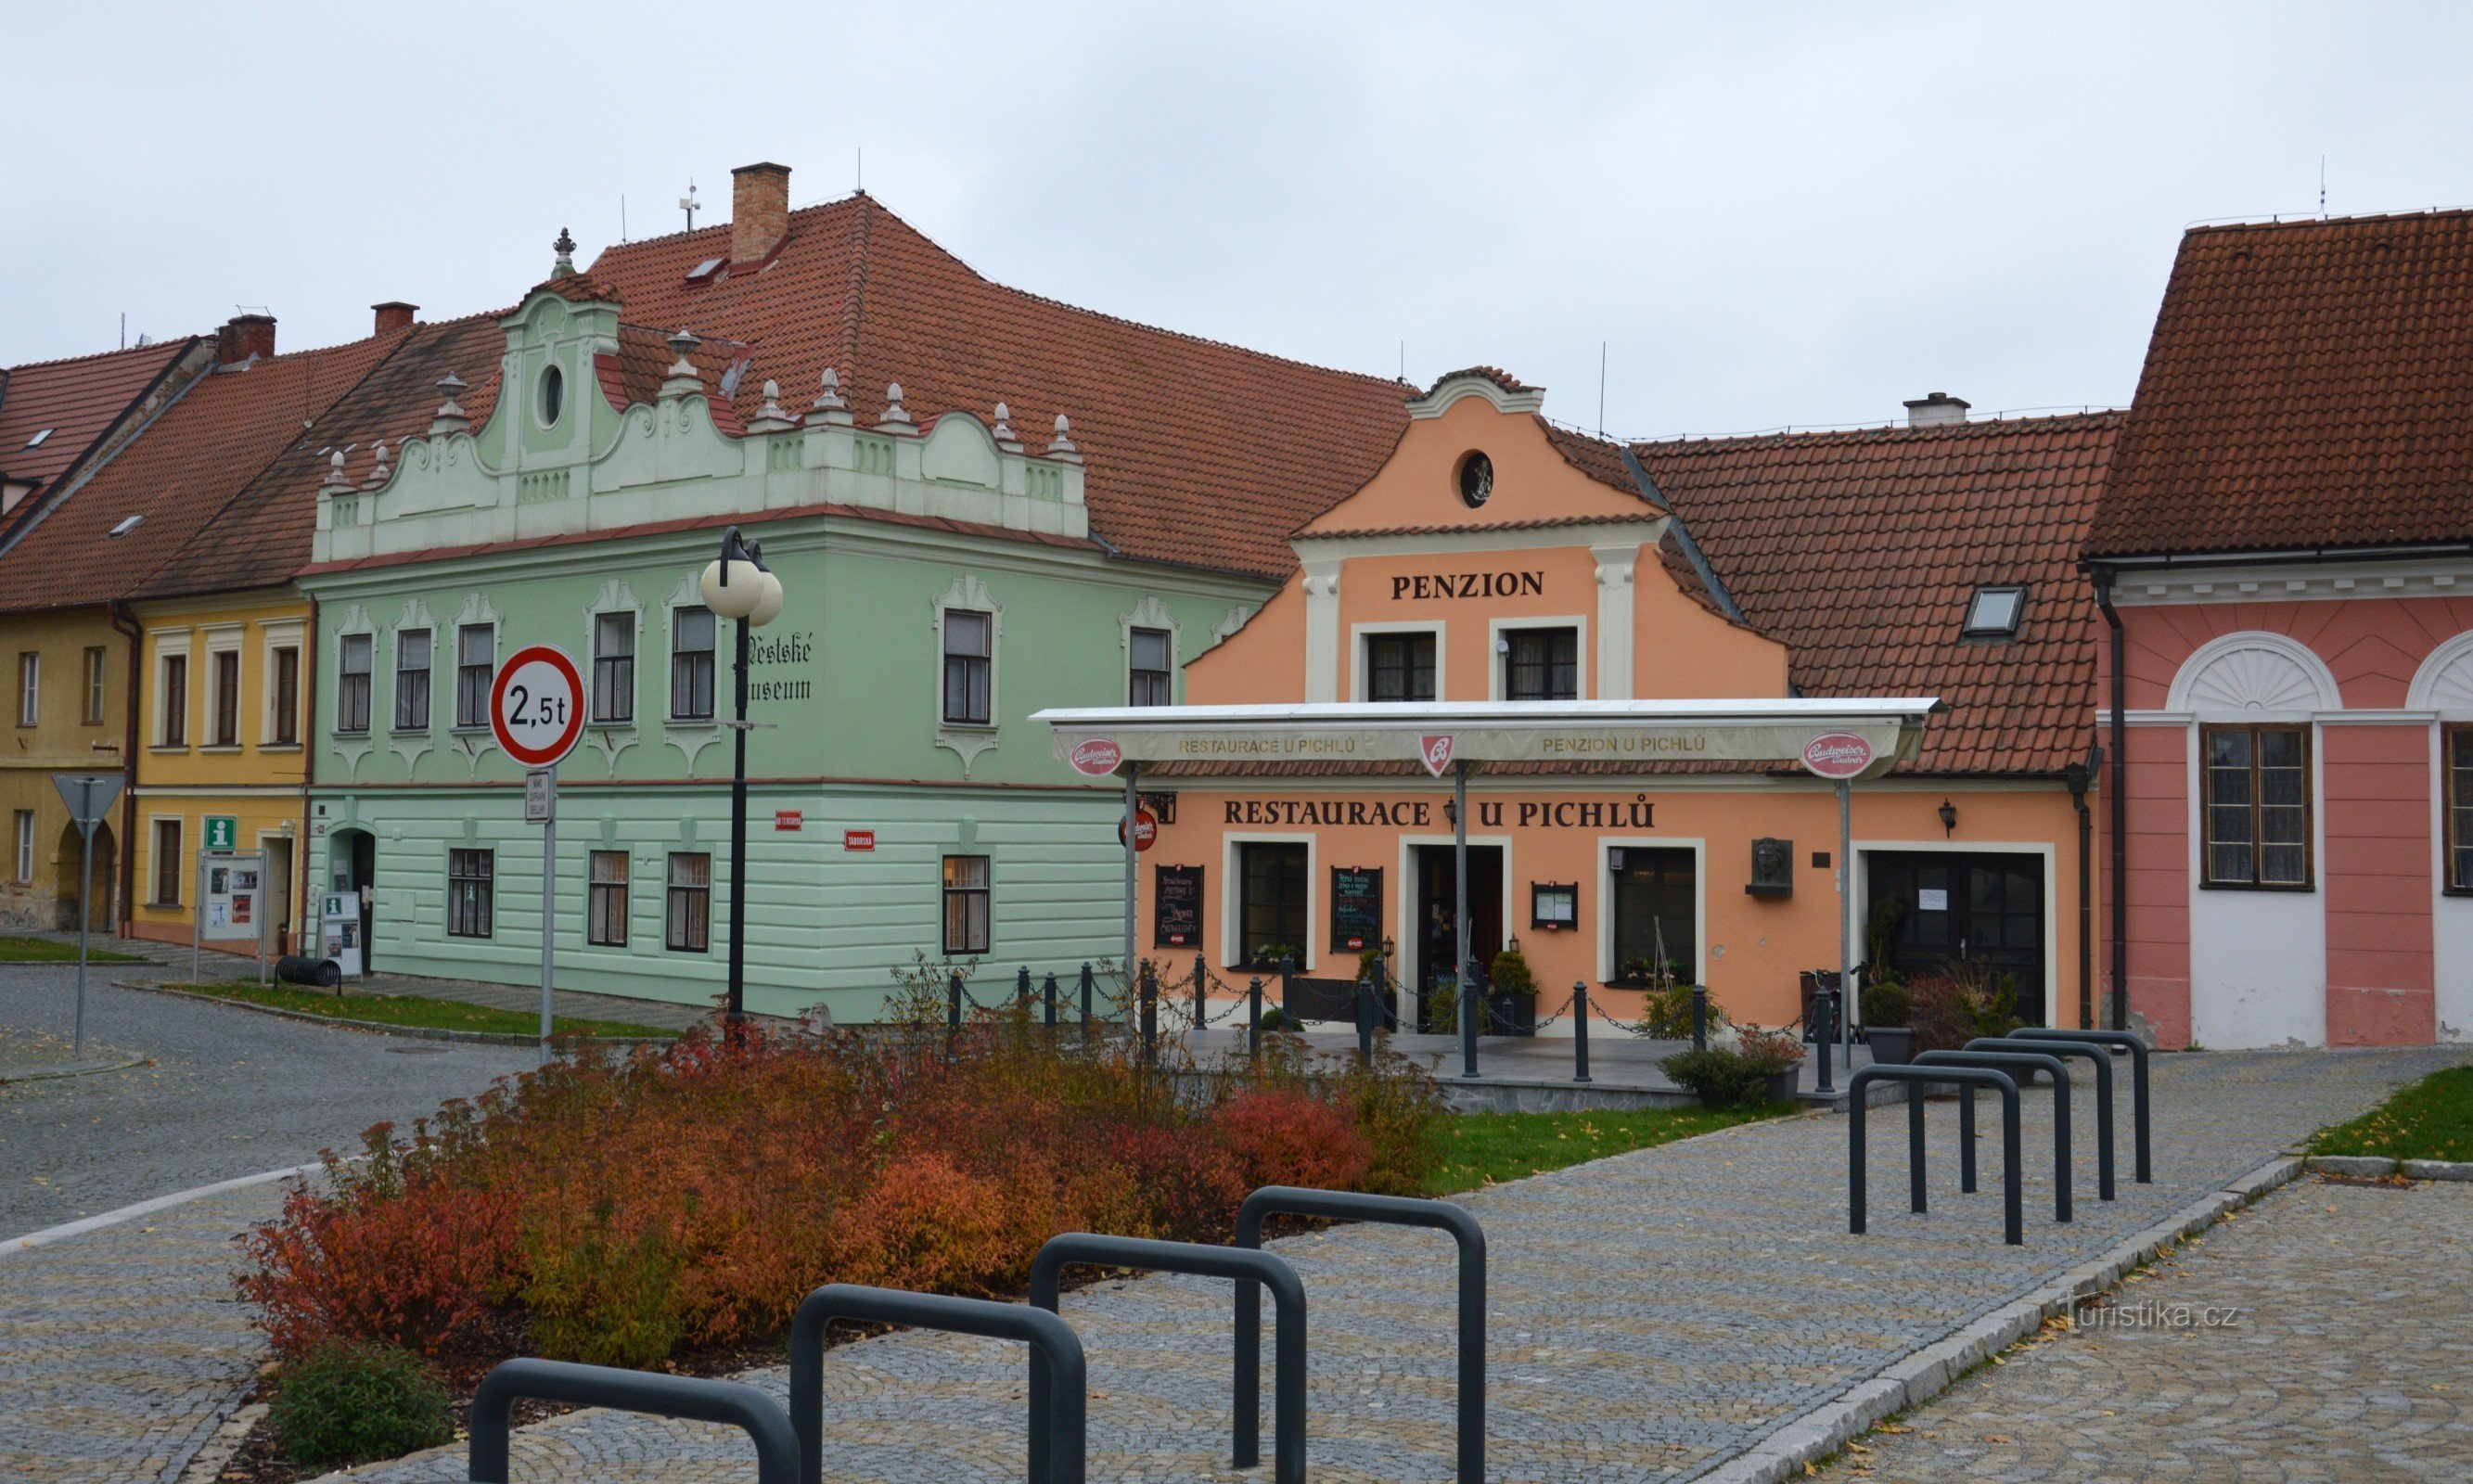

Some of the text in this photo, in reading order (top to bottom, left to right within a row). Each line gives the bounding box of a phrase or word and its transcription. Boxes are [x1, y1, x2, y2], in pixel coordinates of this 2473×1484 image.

[1391, 571, 1544, 600] PENZION
[747, 680, 812, 700] useum
[1179, 736, 1355, 753] RESTAURACE U PICHLŮ
[1544, 734, 1706, 752] PENZION U PICHLŮ
[1075, 748, 1118, 764] Budweiser
[1808, 743, 1866, 762] Budweiser
[1832, 754, 1864, 764] Budvar
[1224, 793, 1655, 828] RESTAURACE U PICHLŮ
[848, 836, 872, 846] TÁBORSKÁ
